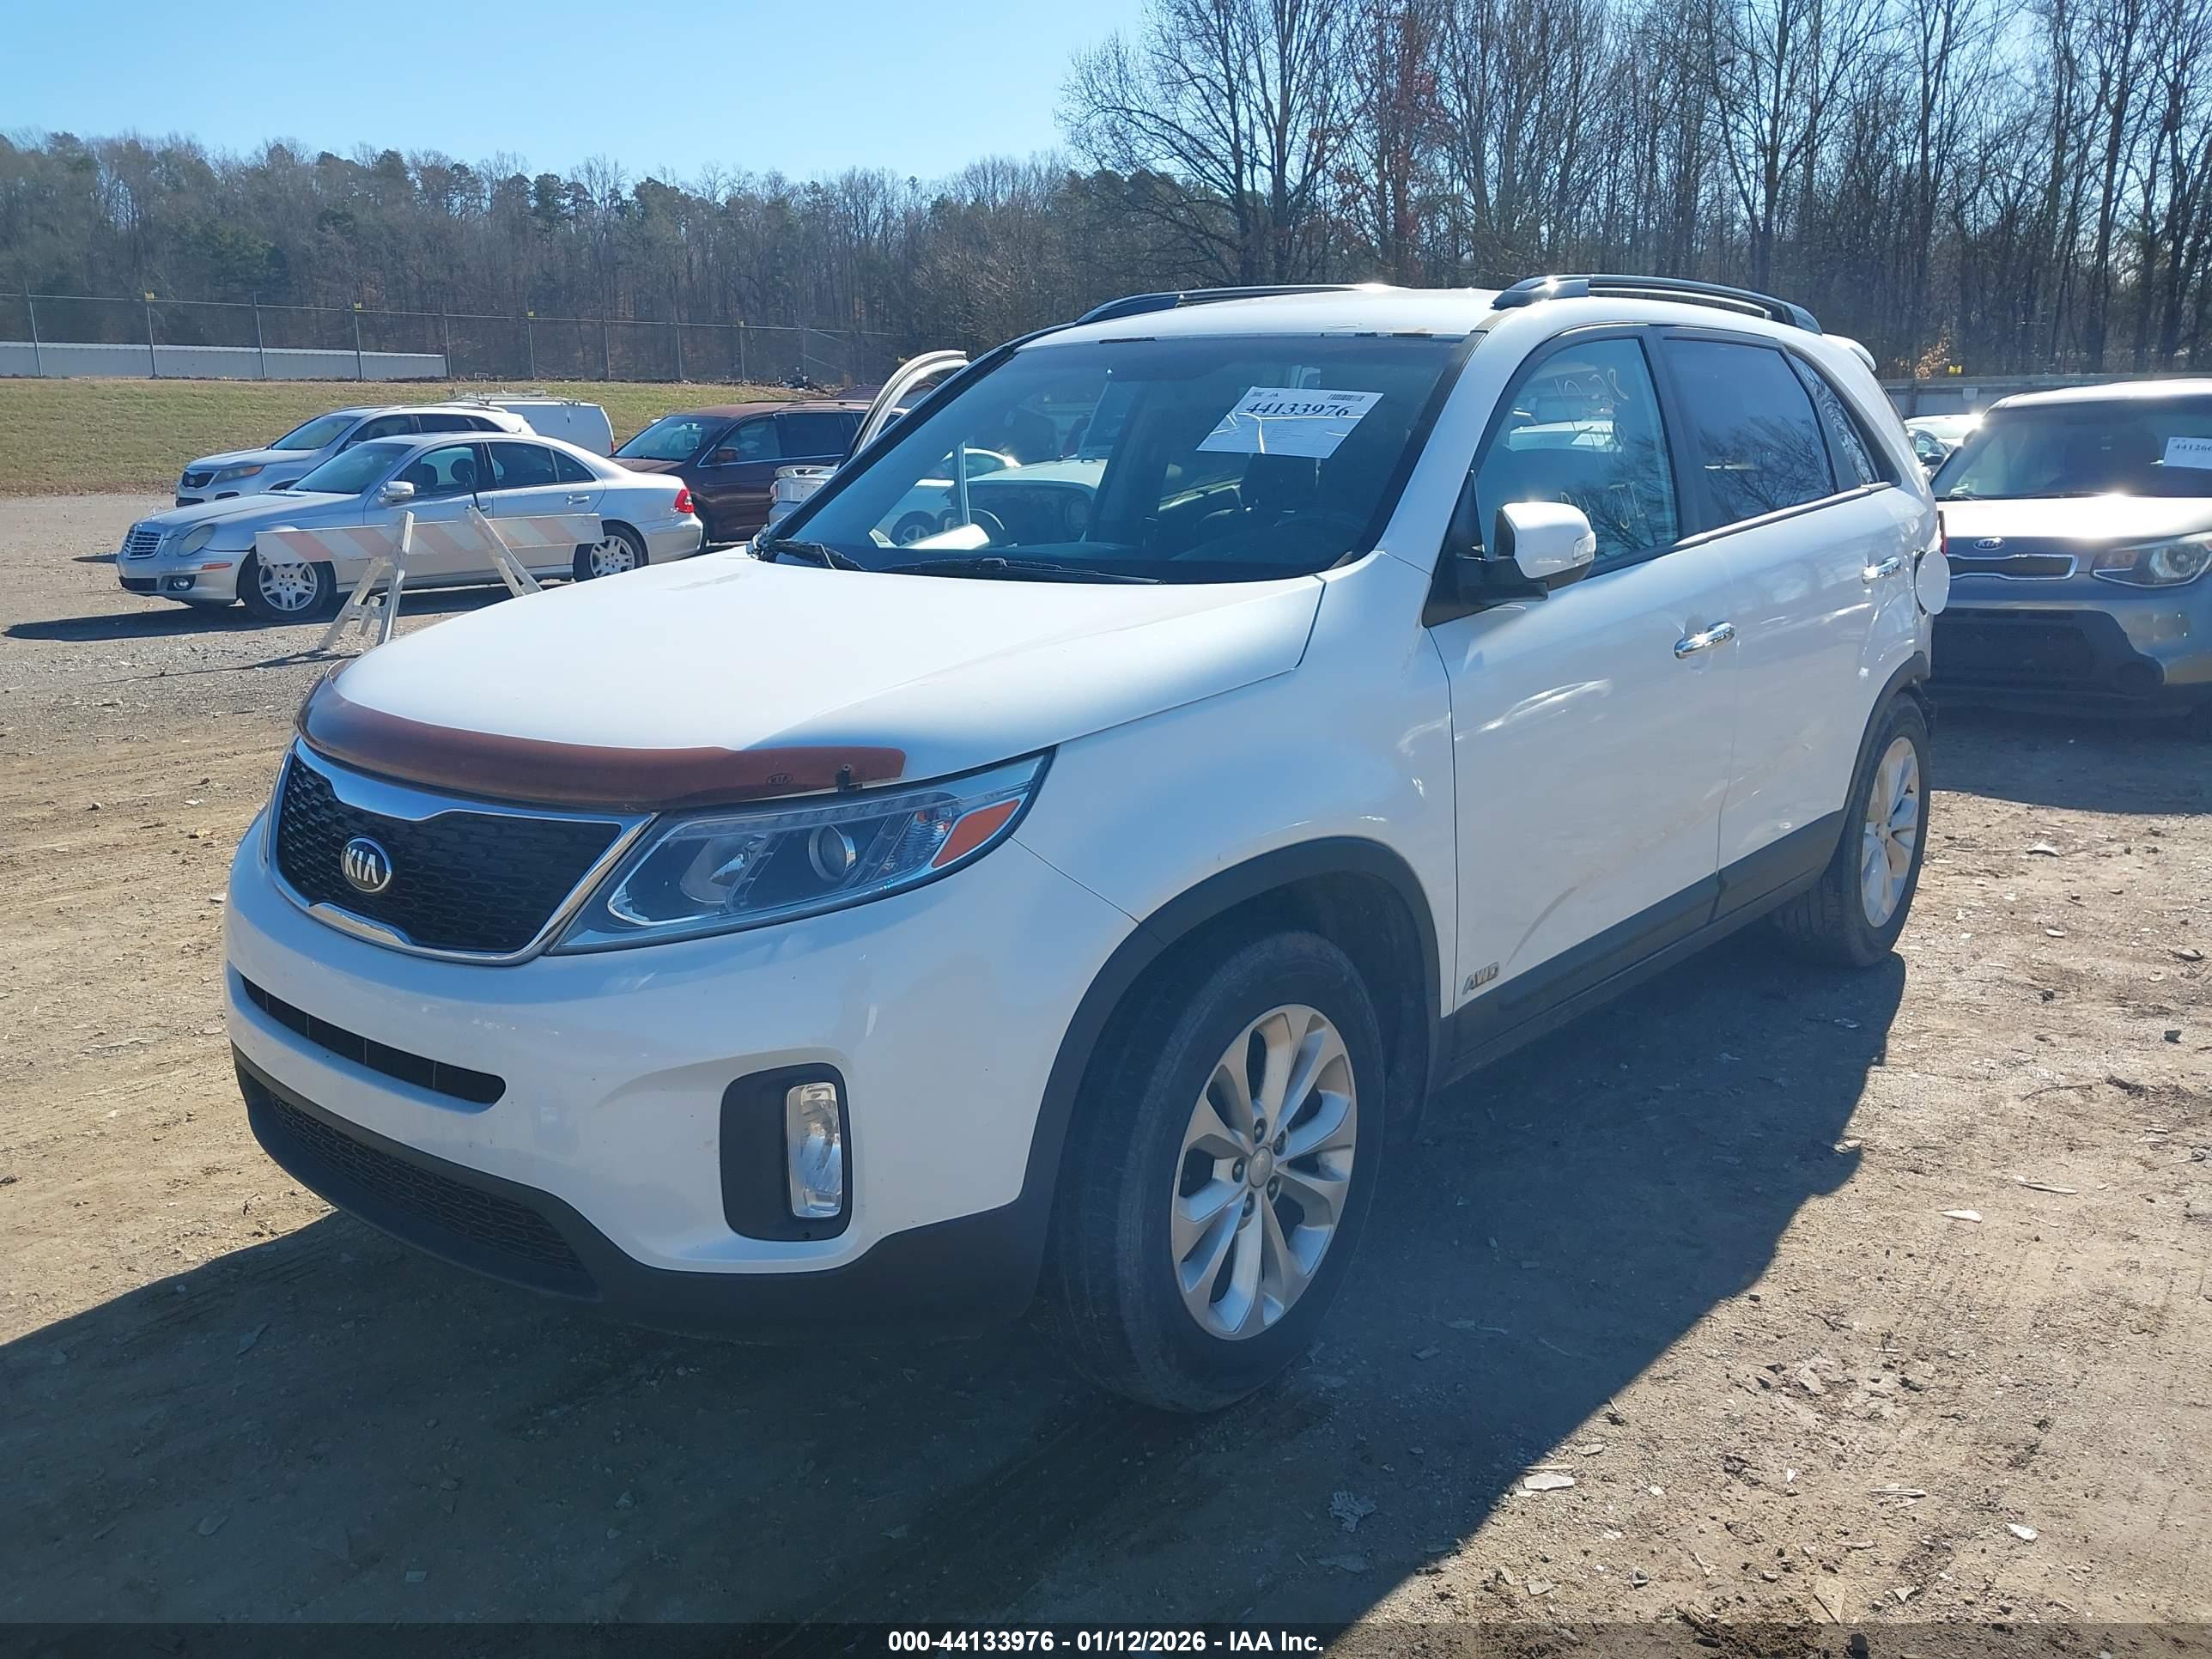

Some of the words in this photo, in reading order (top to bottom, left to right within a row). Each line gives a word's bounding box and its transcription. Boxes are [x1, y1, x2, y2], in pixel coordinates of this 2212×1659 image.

[1245, 402, 1353, 416] 44133976
[345, 847, 379, 884] KIA
[1462, 961, 1499, 996] AWD
